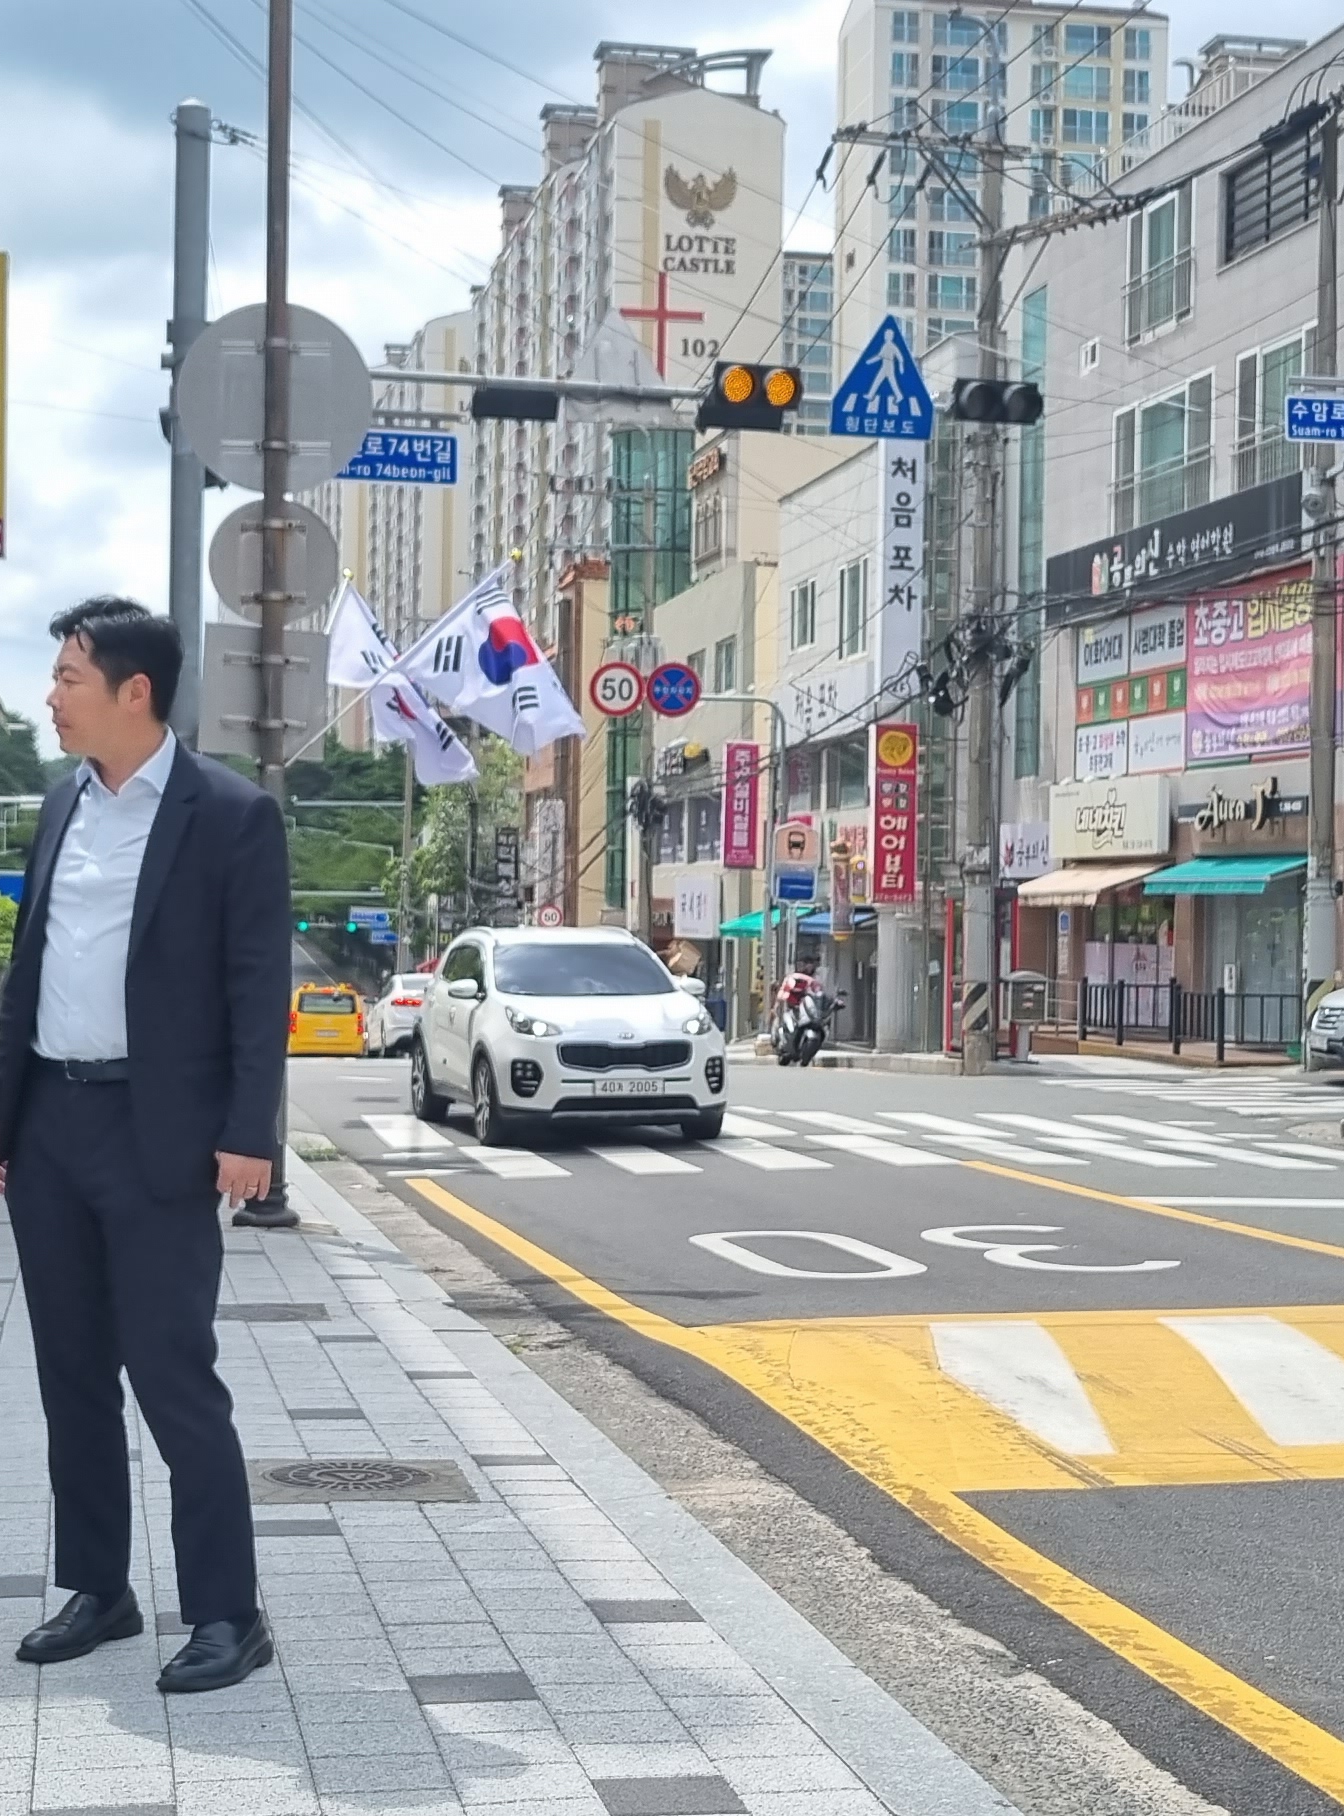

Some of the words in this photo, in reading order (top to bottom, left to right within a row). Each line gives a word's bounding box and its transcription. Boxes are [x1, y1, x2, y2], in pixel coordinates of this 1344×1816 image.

[665, 234, 736, 255] LOTTE
[662, 257, 735, 275] CASTLE
[681, 338, 720, 358] 102
[844, 416, 916, 434] 횡단보도
[1292, 425, 1337, 438] Suam-ro
[375, 463, 452, 482] 74beon-gil
[601, 677, 634, 702] 50
[543, 910, 558, 923] 50
[629, 1081, 658, 1093] 2005
